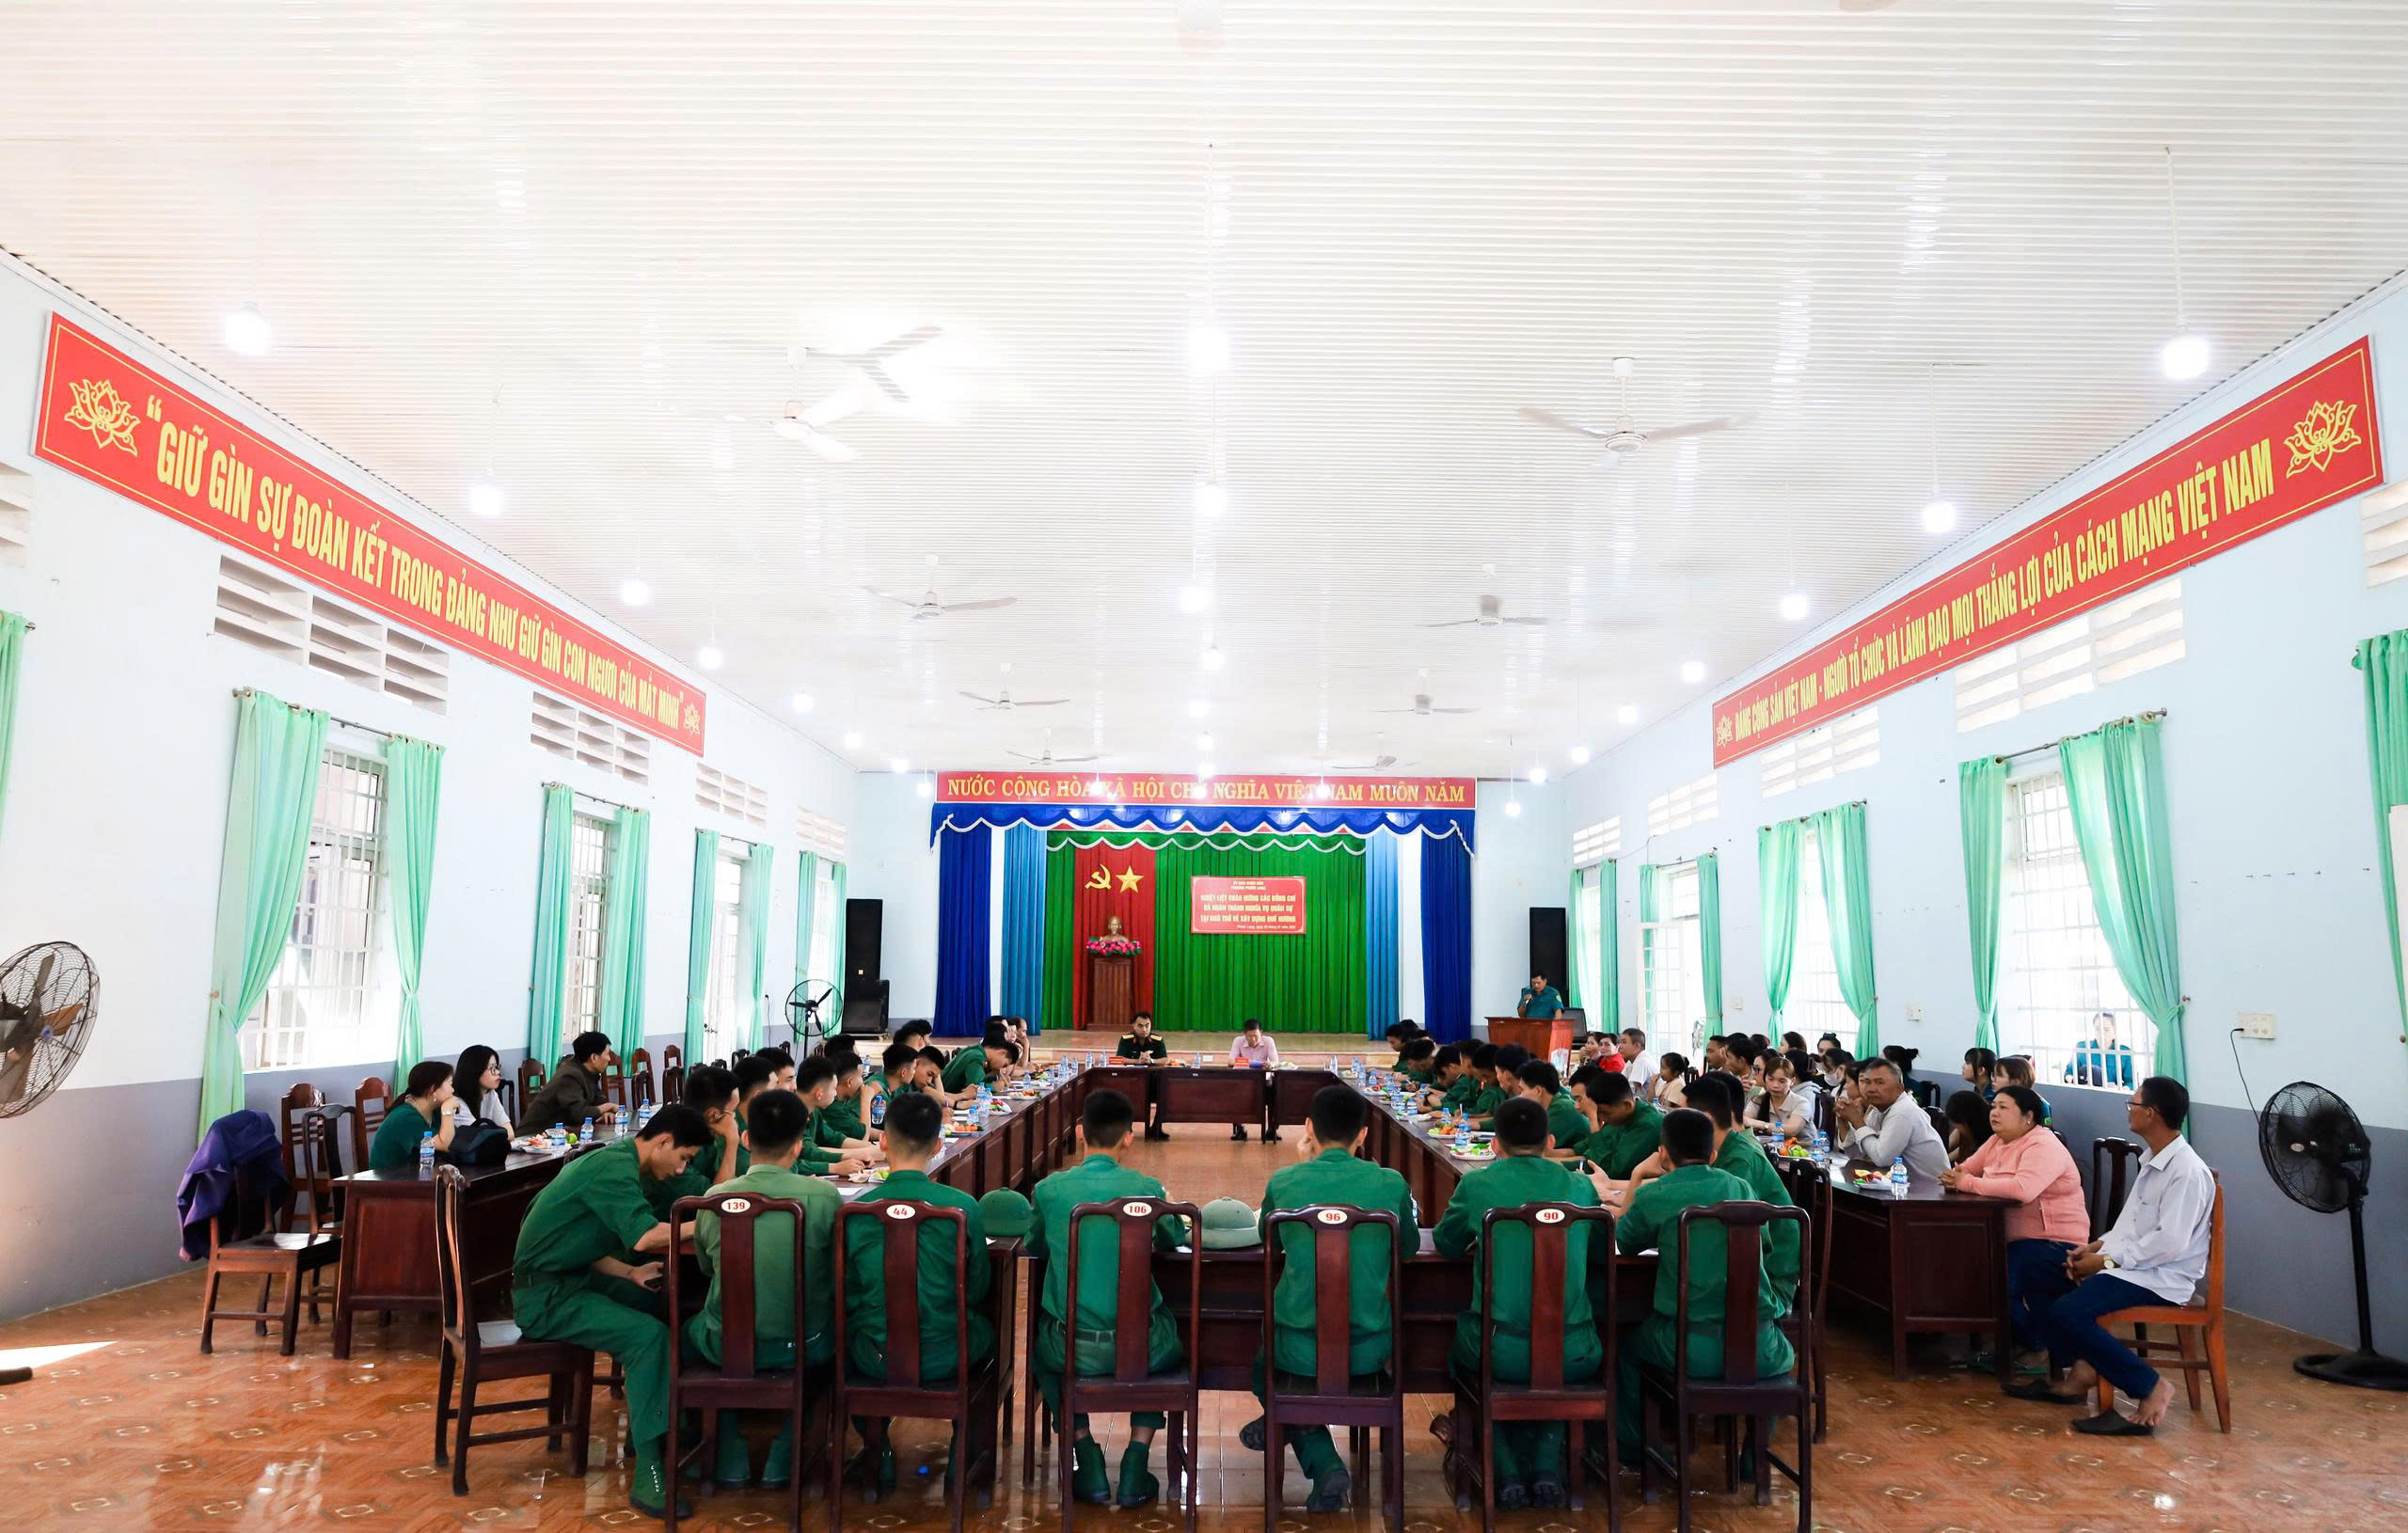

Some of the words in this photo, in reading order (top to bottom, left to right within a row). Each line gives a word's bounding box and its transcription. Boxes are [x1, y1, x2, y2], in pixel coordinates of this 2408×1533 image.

[209, 443, 253, 524] GÌN
[256, 475, 293, 552] SỰ
[292, 494, 350, 572] ĐOÀN
[351, 520, 388, 588] KẾT
[390, 545, 444, 617] TRONG
[445, 567, 486, 638] ĐẢNG
[488, 598, 518, 652] NHƯ
[518, 613, 542, 663] GIỮ
[541, 621, 562, 674] GÌN
[563, 639, 586, 686] CON
[619, 660, 637, 711] CỦA
[639, 671, 657, 719] MẮT
[1735, 699, 1751, 742] ĐẢNG
[1751, 694, 1769, 739] CỘNG
[1769, 681, 1784, 726] SẢN
[1784, 677, 1799, 723] VIỆT
[1799, 672, 1818, 712] NAM
[1823, 648, 1847, 701] NGƯỜI
[1848, 635, 1861, 689] TỔ
[1861, 633, 1885, 684] CHỨC
[1885, 623, 1899, 672] VÀ
[1899, 615, 1926, 665] LÃNH
[1927, 604, 1950, 657] ĐẠO
[1951, 592, 1975, 645] MỌI
[1975, 562, 2018, 629] THẮNG
[2019, 554, 2041, 617] LỢI
[2043, 529, 2074, 598] CỦA
[2075, 518, 2118, 583] CÁCH
[2121, 489, 2175, 566] MẠNG
[2177, 461, 2217, 540] VIỆT
[2222, 437, 2274, 515] NAM
[947, 774, 996, 797] NƯỚC
[1002, 775, 1051, 800] CỘNG
[1132, 776, 1165, 802] HỘI
[1212, 779, 1271, 800] NGHĨA
[1370, 781, 1418, 802] MUÔN
[1425, 782, 1465, 802] NĂM
[727, 1201, 746, 1210] 139
[1128, 1205, 1148, 1214] 106
[893, 1207, 908, 1216] 44
[1544, 1211, 1559, 1221] 90
[1325, 1212, 1341, 1222] 96
